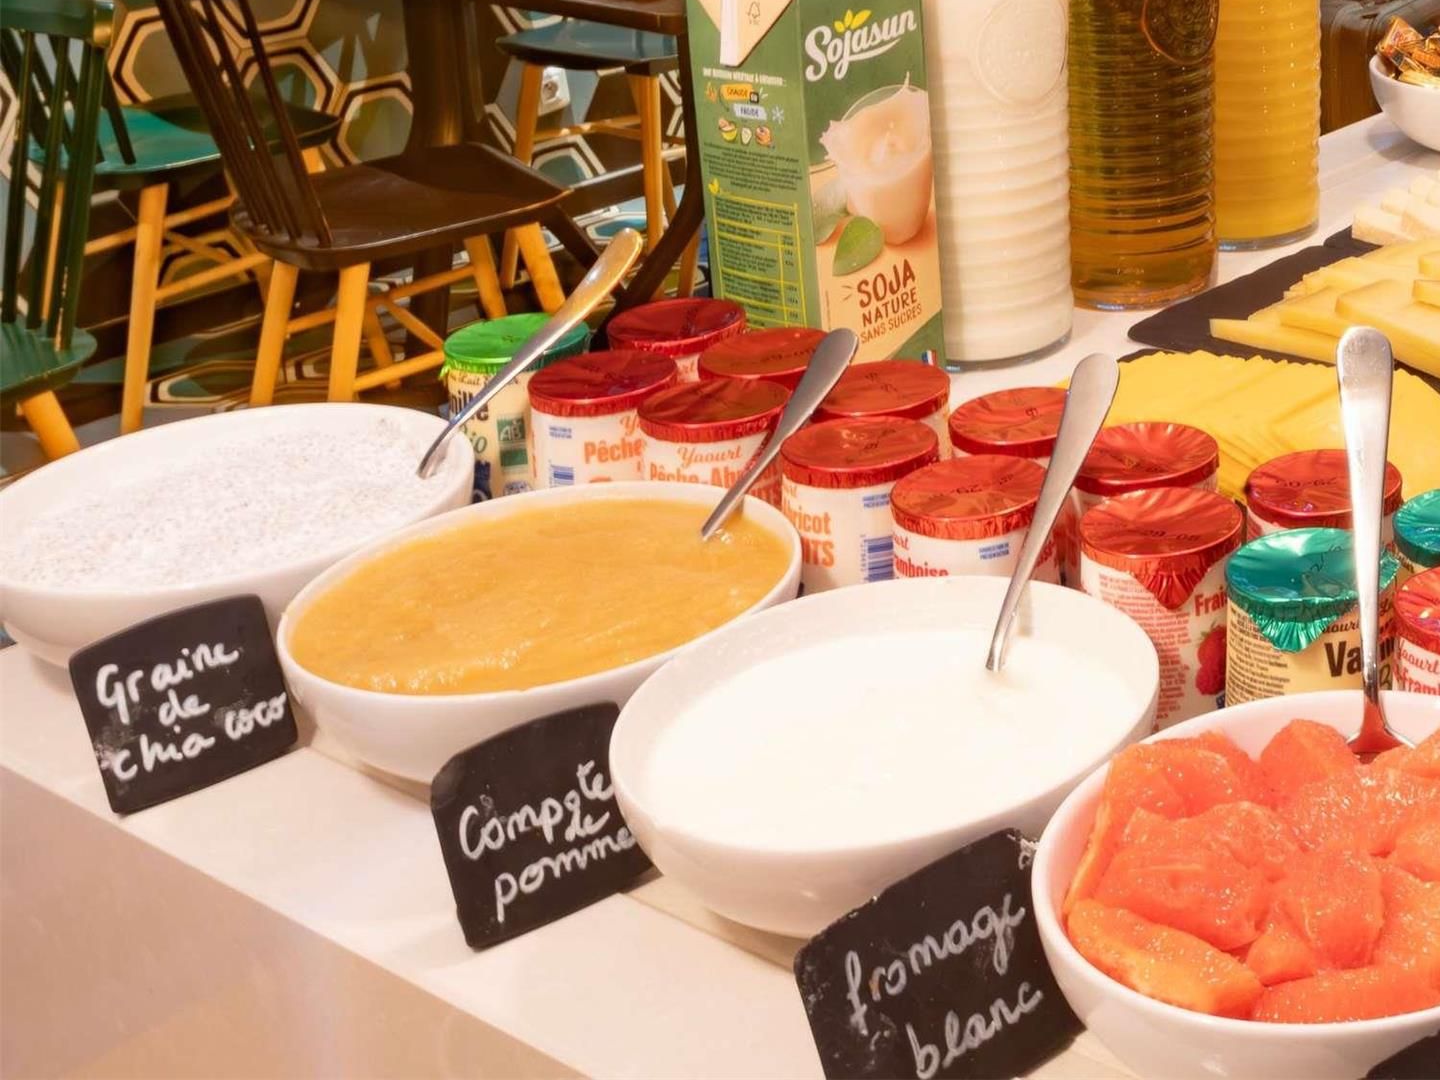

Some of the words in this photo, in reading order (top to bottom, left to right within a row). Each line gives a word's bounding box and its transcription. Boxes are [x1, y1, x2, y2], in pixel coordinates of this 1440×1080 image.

[805, 9, 918, 81] Sojasun
[857, 259, 916, 309] SOJA
[862, 286, 917, 327] NATURE
[860, 322, 887, 344] SANS
[888, 303, 922, 332] SUCRES
[96, 642, 240, 725] Graine
[158, 689, 210, 726] de
[224, 691, 288, 741] coco
[459, 760, 615, 861] Compote
[905, 982, 1044, 1080] blanc
